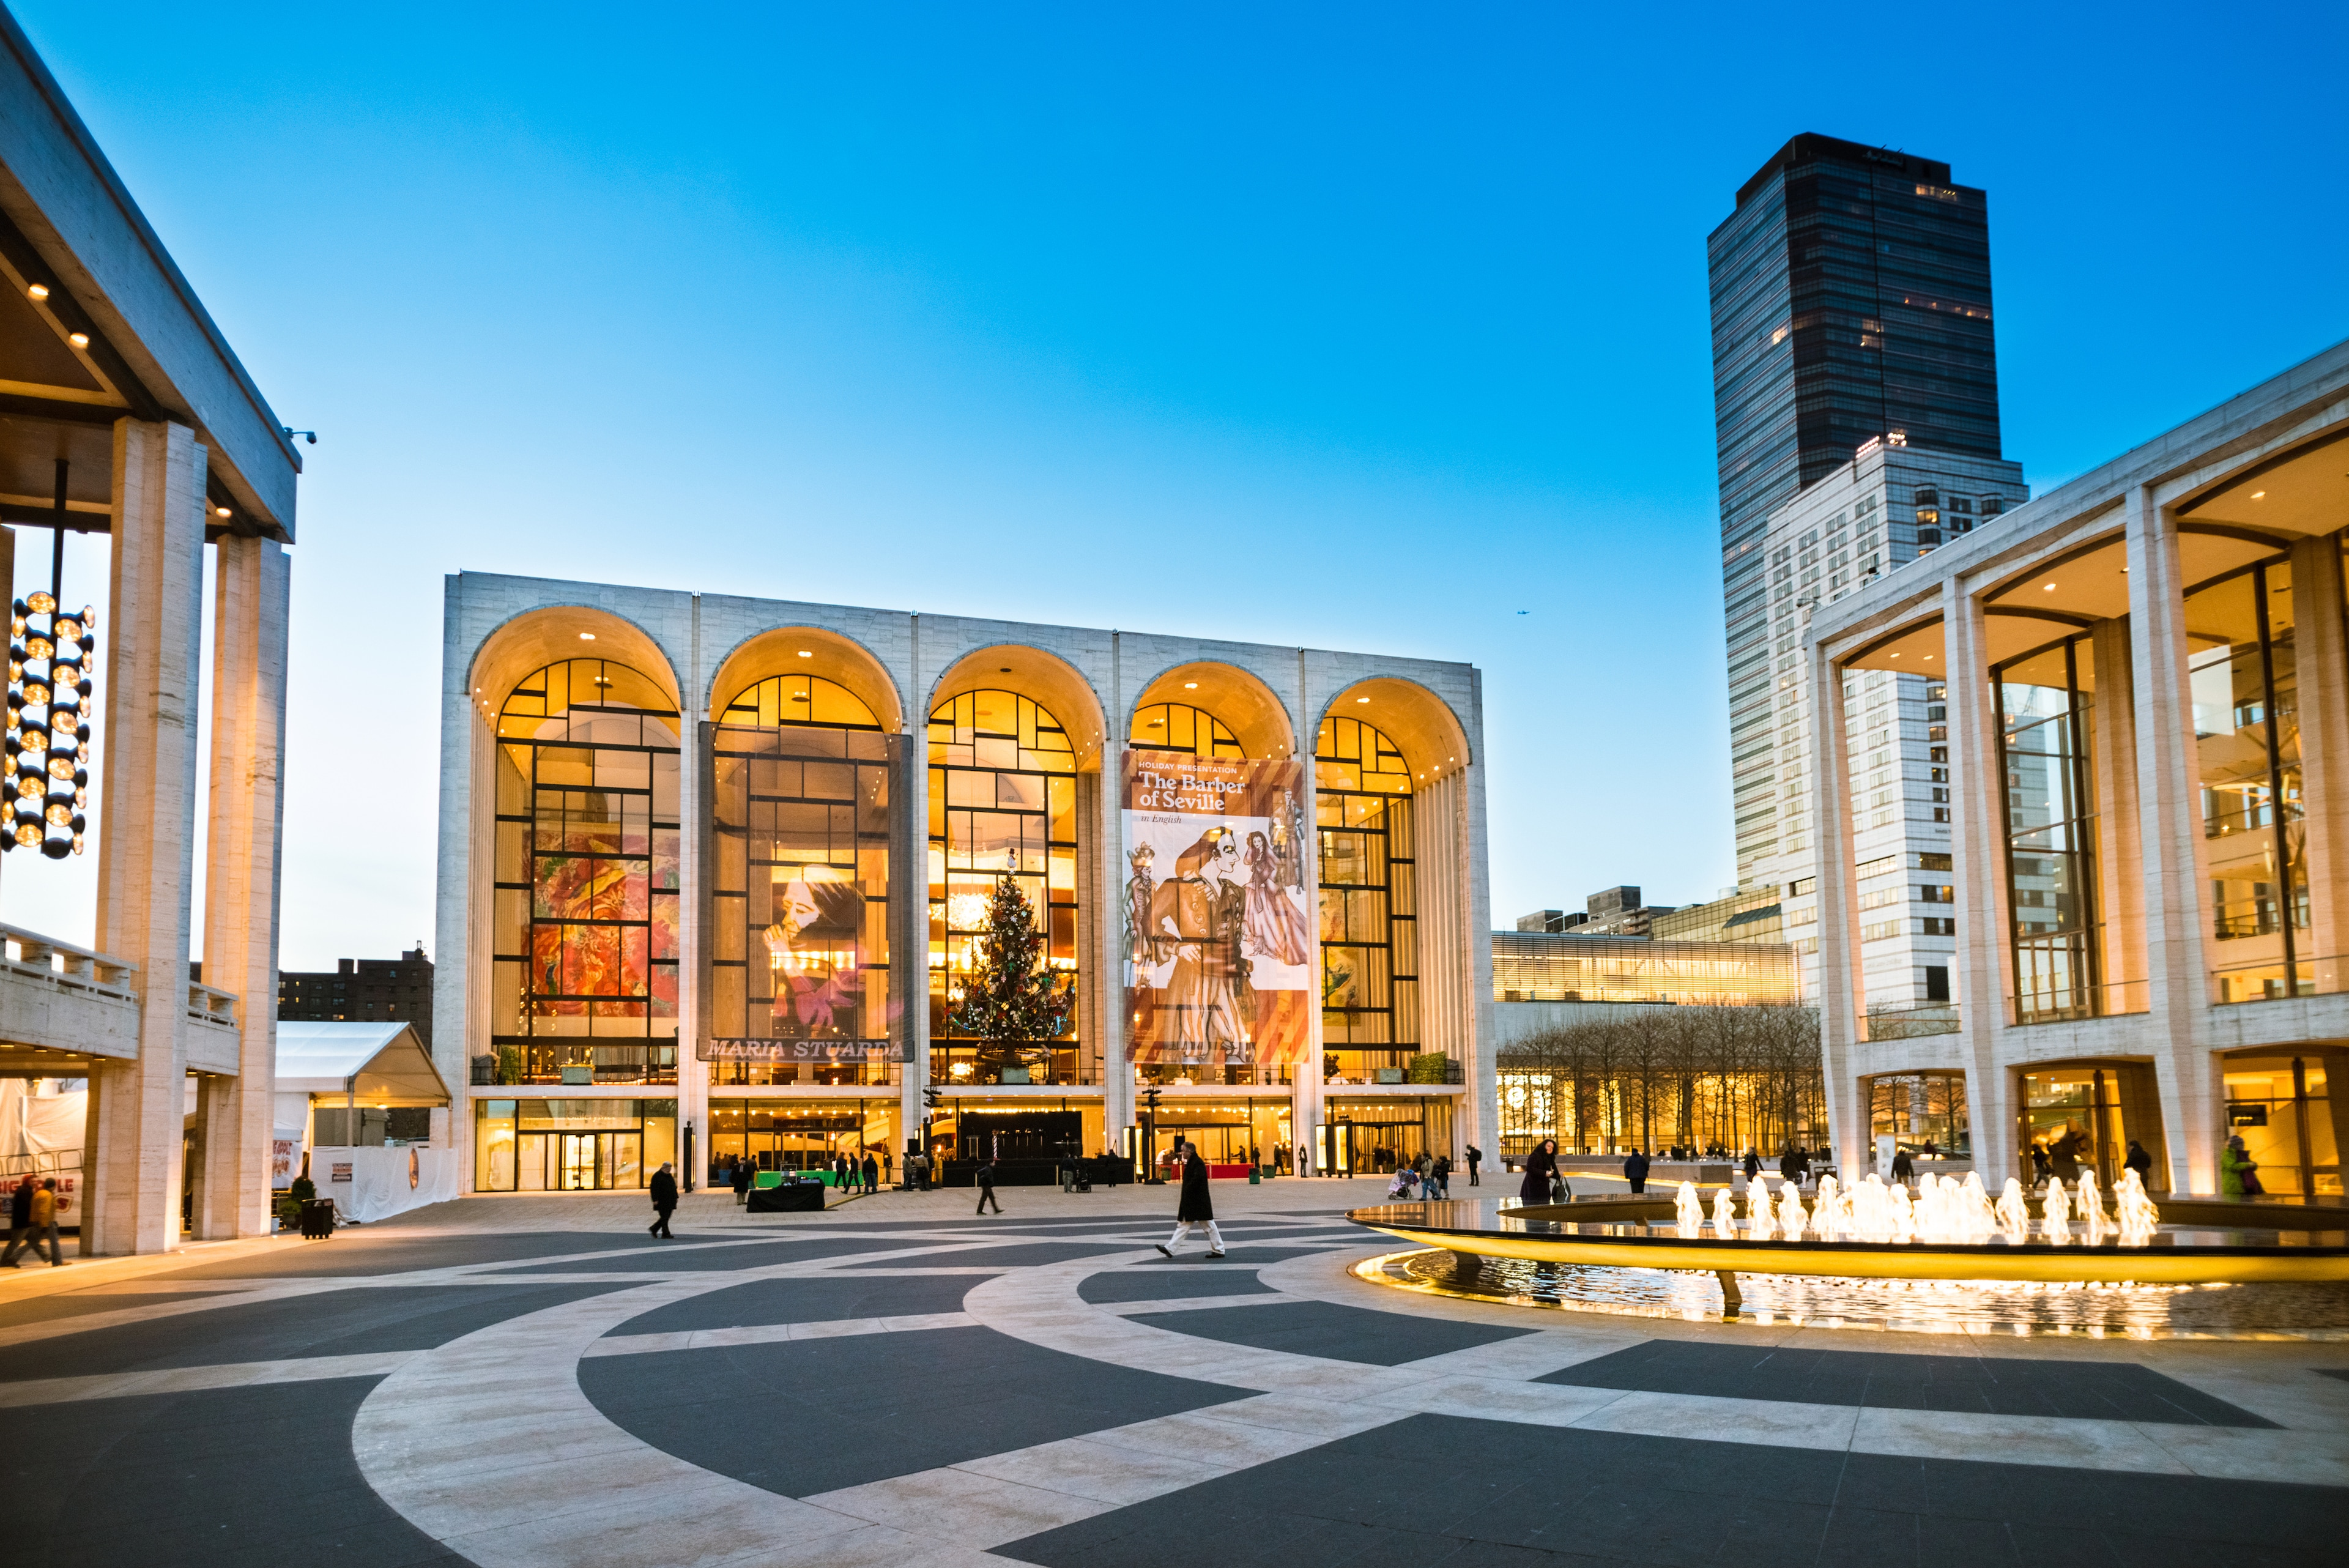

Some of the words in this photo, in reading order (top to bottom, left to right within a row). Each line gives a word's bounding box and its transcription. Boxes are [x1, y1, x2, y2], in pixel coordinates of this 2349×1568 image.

[1138, 761, 1174, 770] HOLIDAY
[1178, 764, 1238, 774] PRESENTATION
[1138, 771, 1177, 790] The
[1181, 774, 1245, 794] Barber
[1140, 791, 1159, 807] of
[1162, 792, 1225, 811] Seville
[1141, 814, 1150, 822] in
[1152, 814, 1182, 826] English
[706, 1039, 785, 1057] MARIA
[793, 1041, 904, 1057] STUARDA
